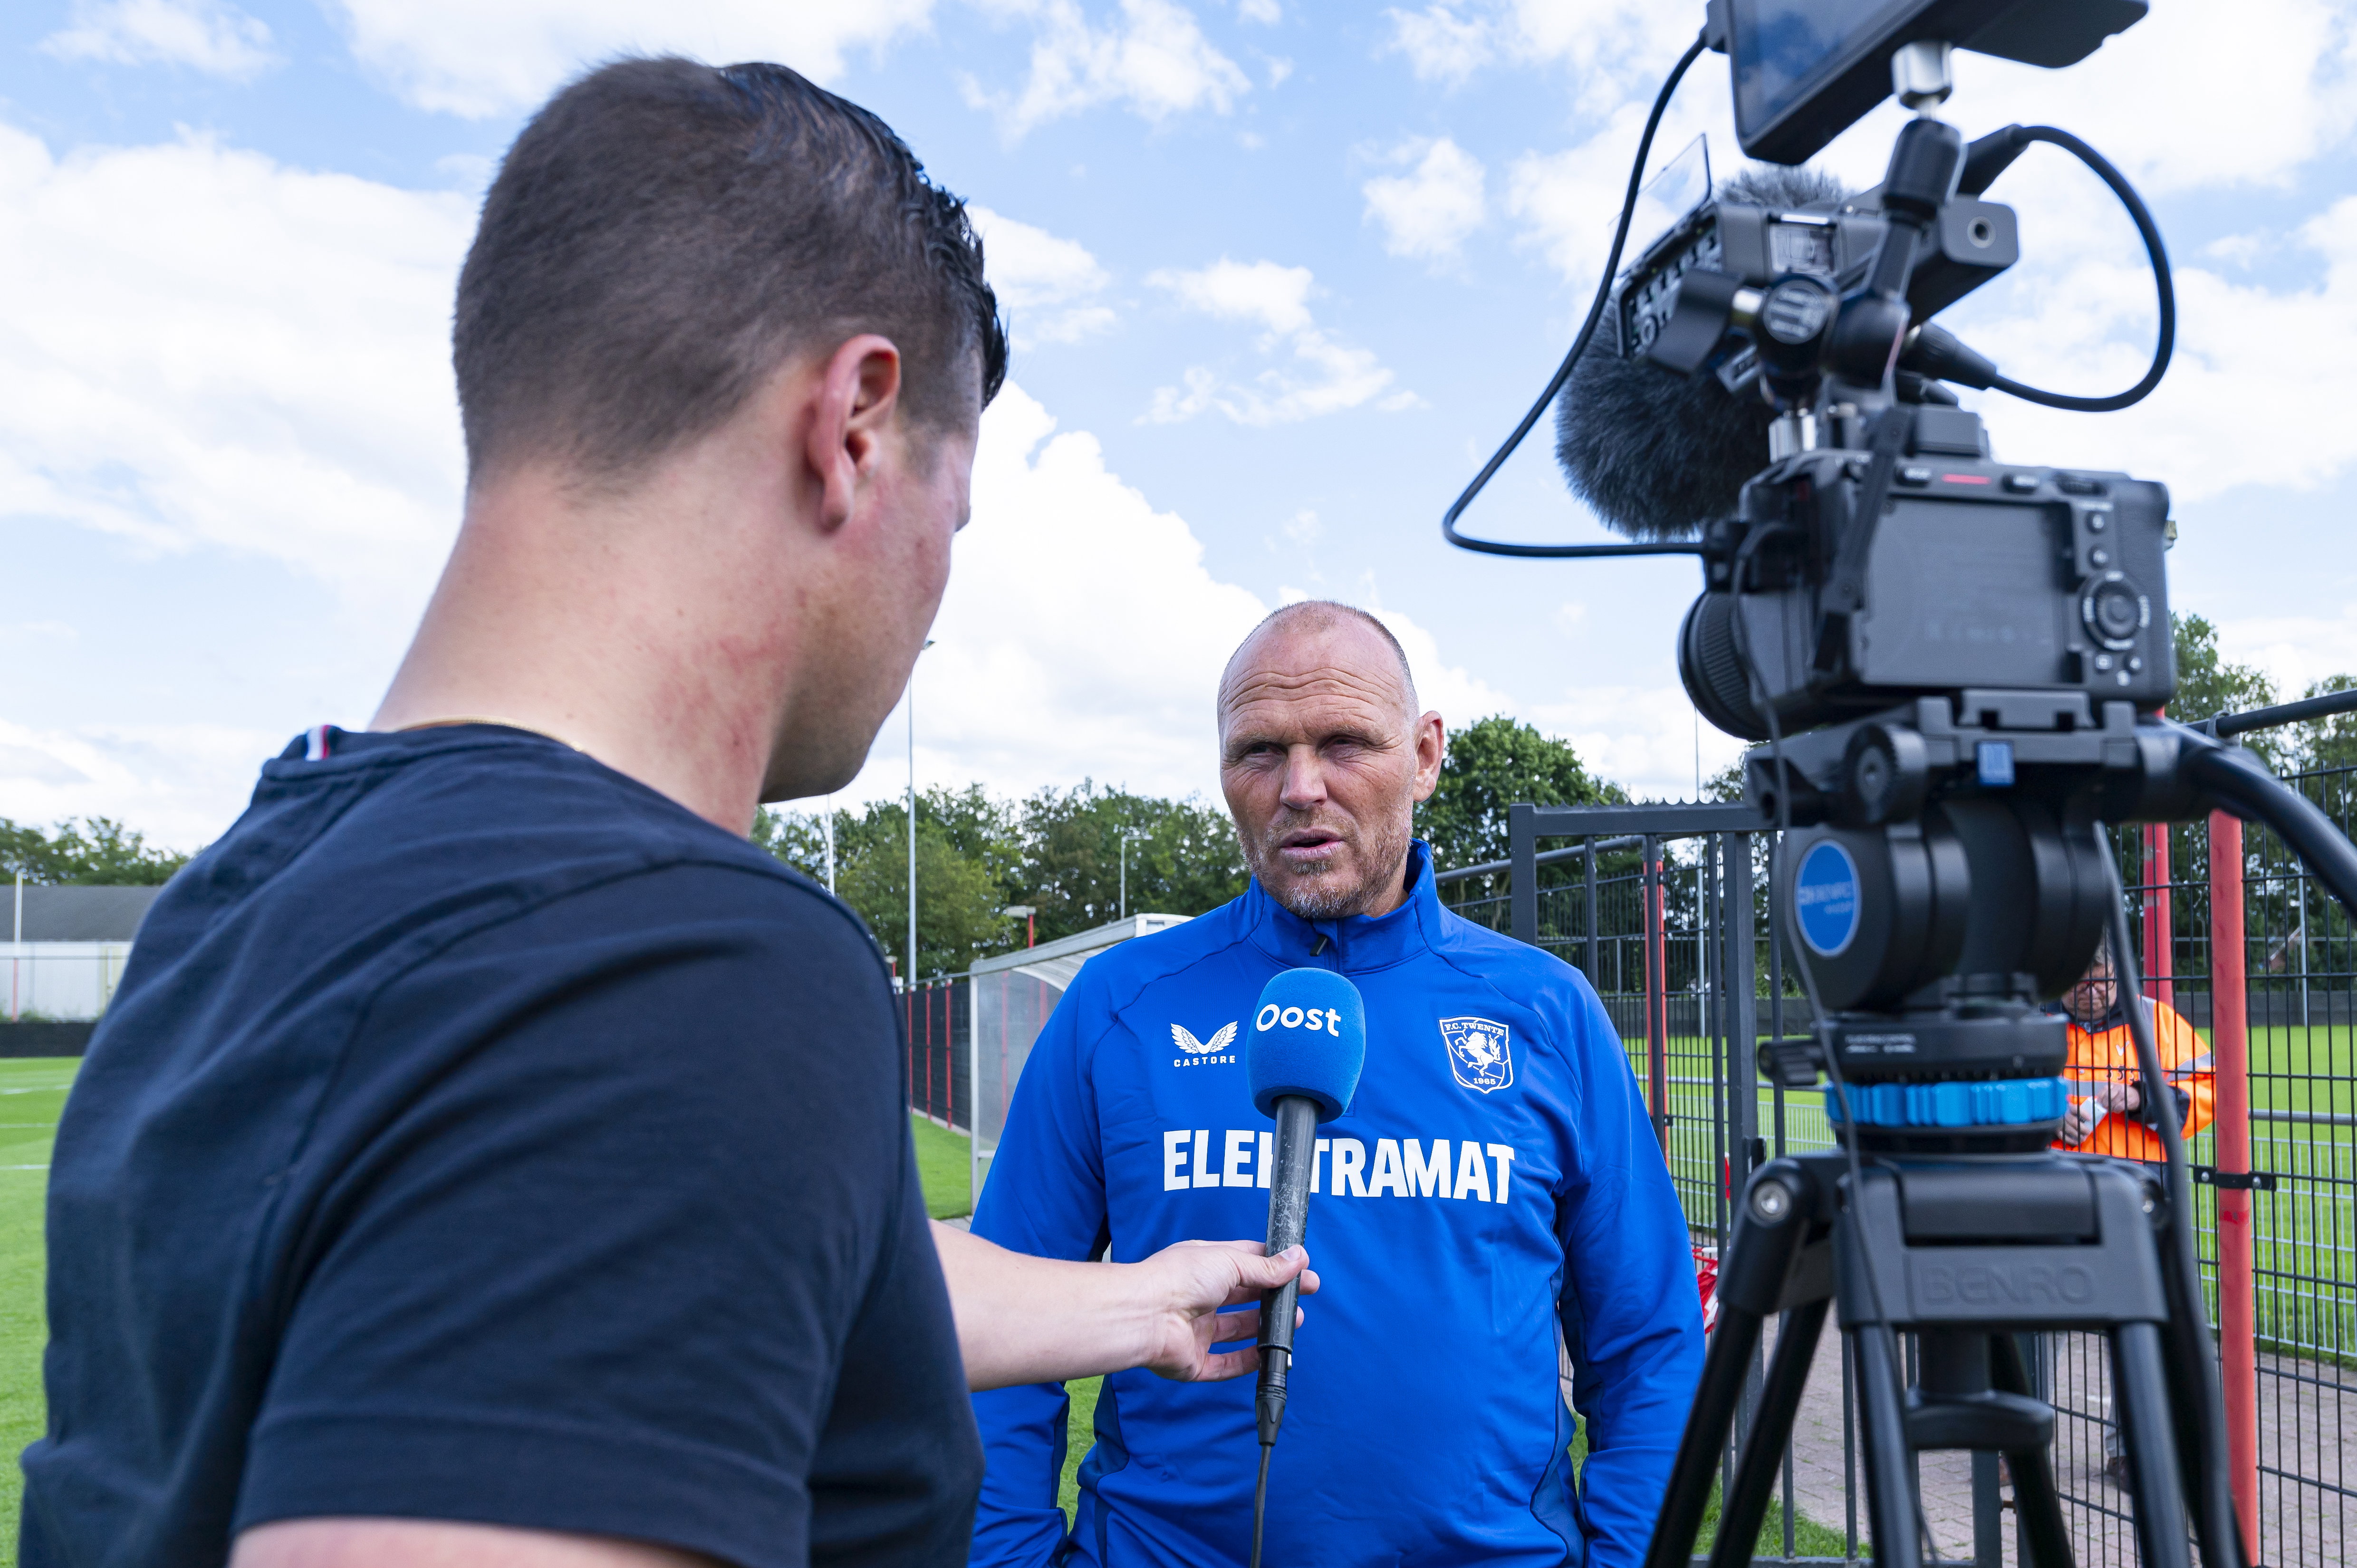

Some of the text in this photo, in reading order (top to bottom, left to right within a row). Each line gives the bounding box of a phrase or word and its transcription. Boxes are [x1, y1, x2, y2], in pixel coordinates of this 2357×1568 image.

[1256, 1004, 1341, 1037] Oost
[1444, 1022, 1505, 1036] F.C. TWENTE
[1174, 1055, 1235, 1068] CASTORE
[1919, 1265, 2096, 1305] BENRO
